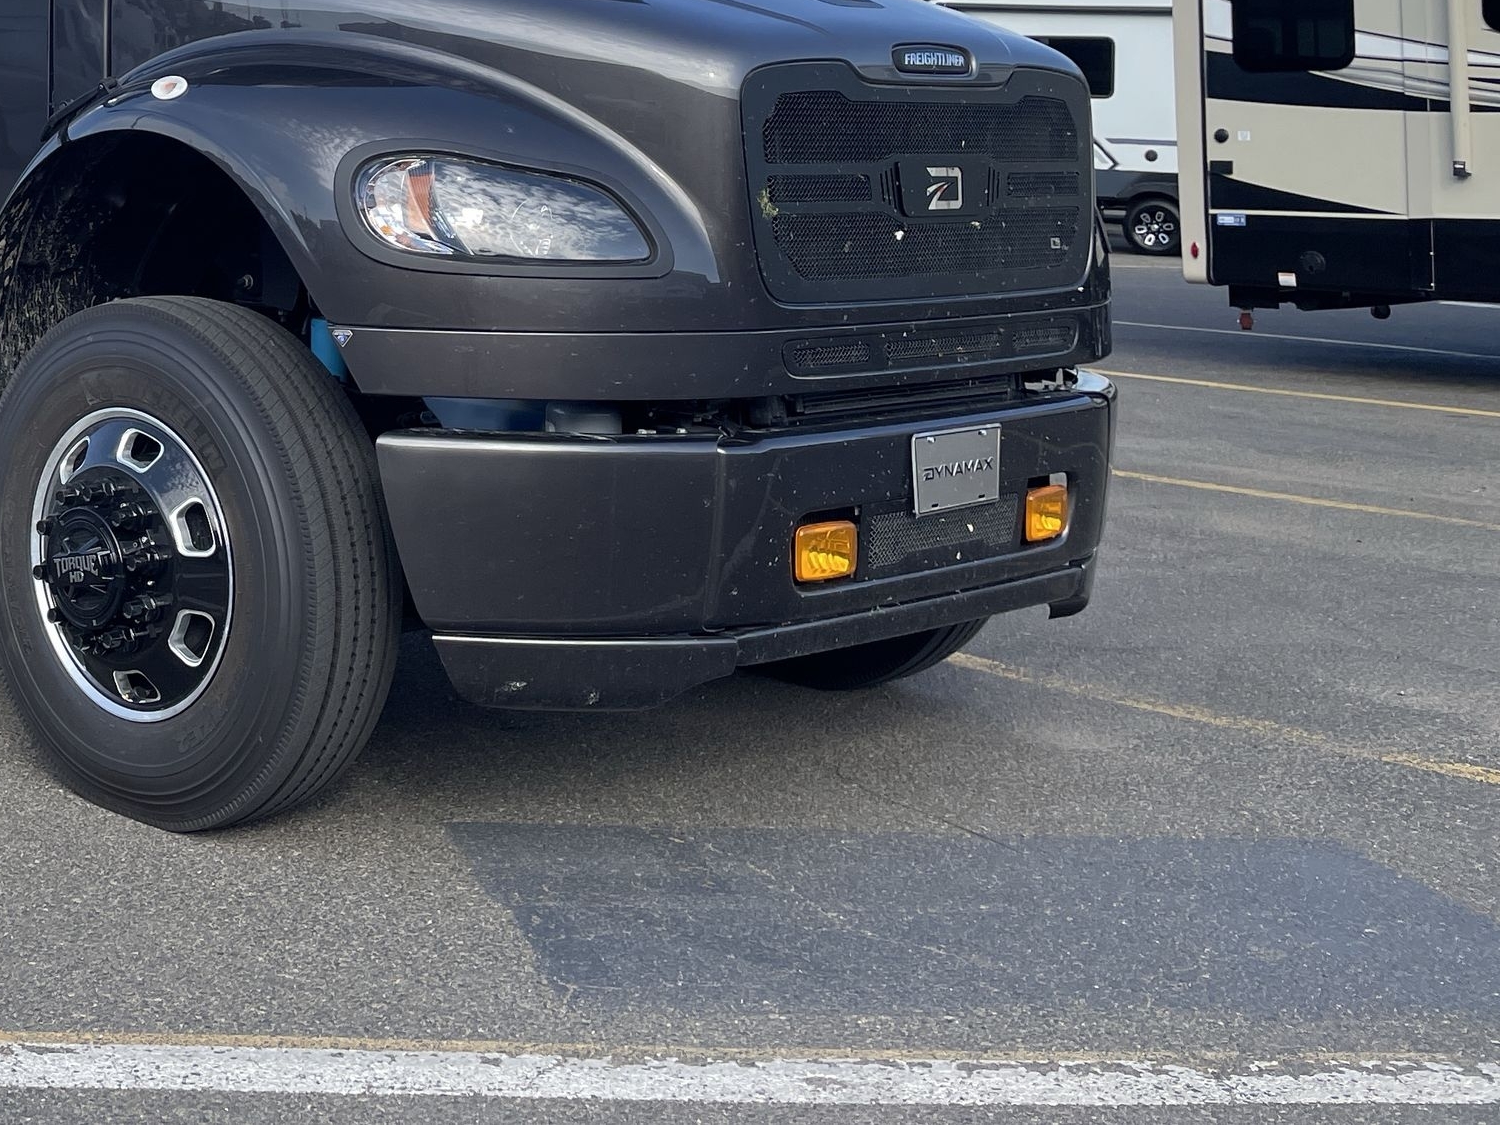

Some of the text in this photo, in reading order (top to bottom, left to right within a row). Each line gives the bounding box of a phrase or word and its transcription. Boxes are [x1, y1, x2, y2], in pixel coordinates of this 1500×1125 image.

[904, 52, 965, 67] FREIGHTLINER
[923, 456, 994, 482] DYNAMAX
[53, 555, 99, 578] TORQUE
[69, 571, 84, 583] HD
